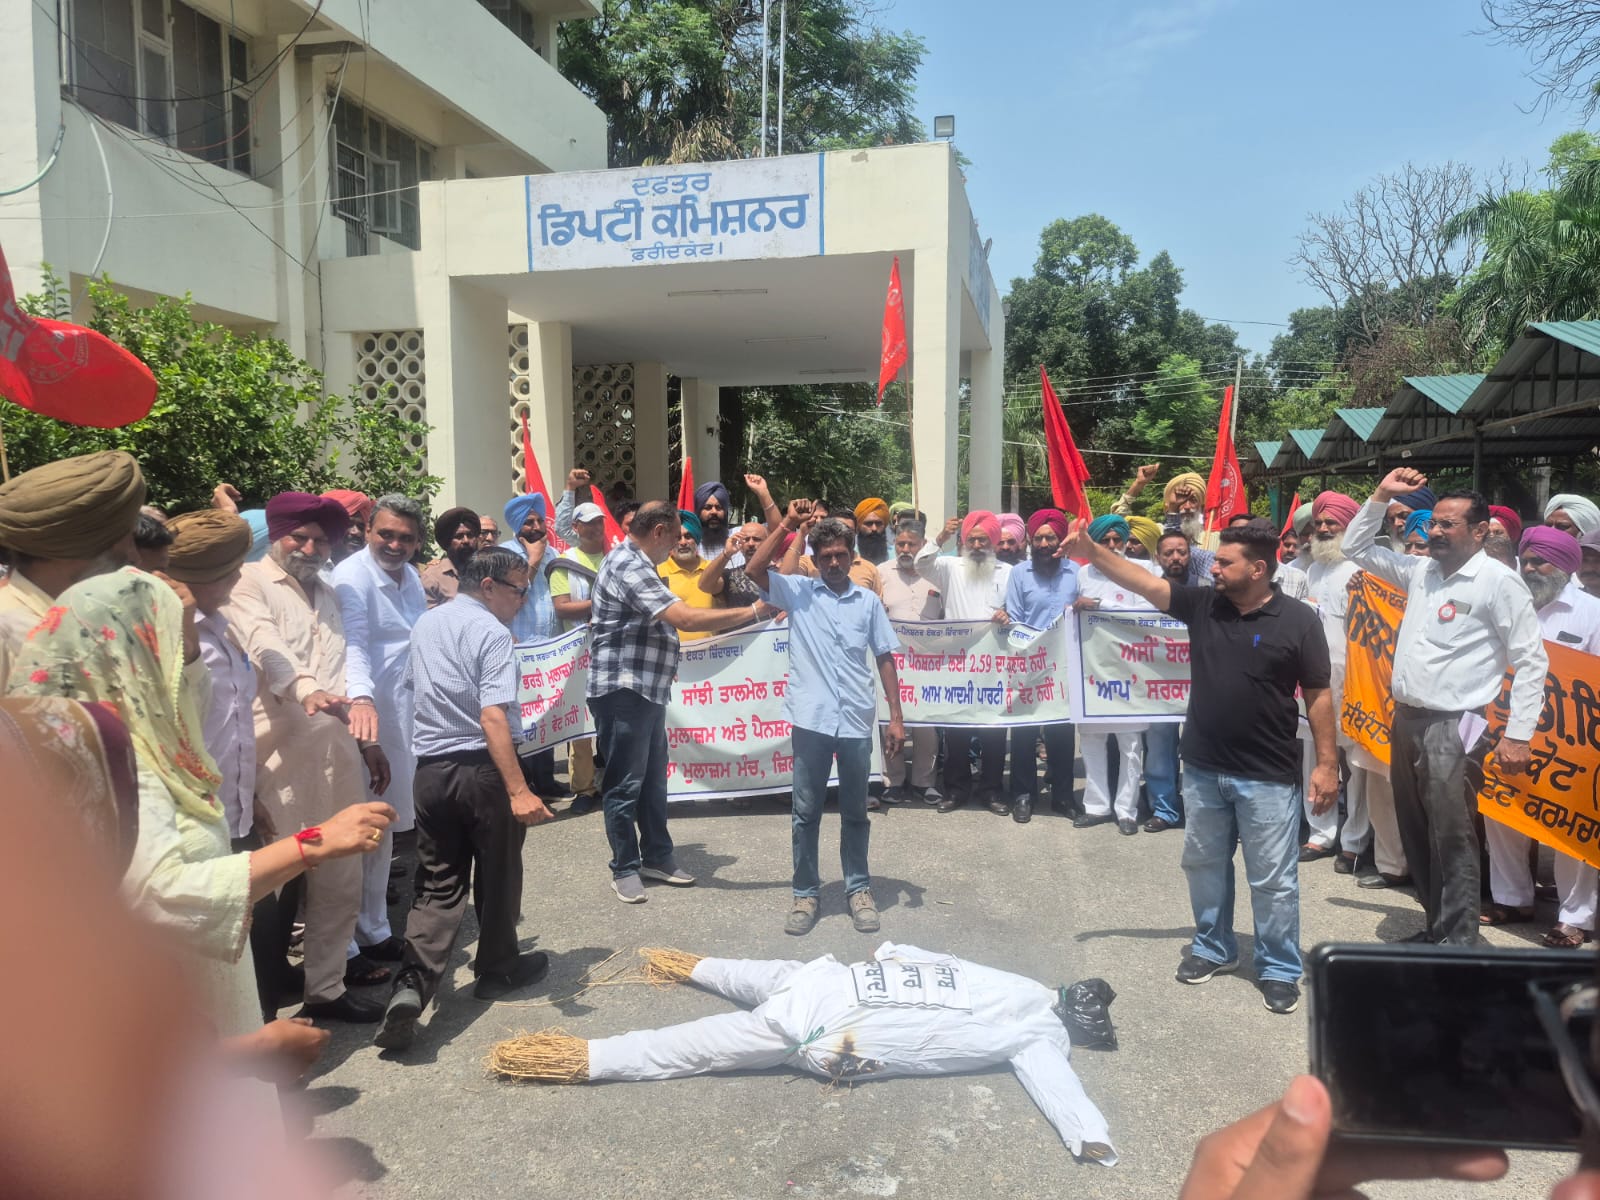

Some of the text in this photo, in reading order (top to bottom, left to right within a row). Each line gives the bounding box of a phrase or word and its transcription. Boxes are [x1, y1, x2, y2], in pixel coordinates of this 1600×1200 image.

[538, 193, 810, 246] ਡਿਪਟੀ ਕਮਿਸ਼ਨਰ
[969, 654, 992, 673] 2.59
[945, 680, 974, 705] ਆਦਮੀ
[977, 680, 1003, 705] ਪਾਰਟੀ
[1145, 679, 1191, 701] ਸਰਕਾ
[721, 717, 748, 743] ਅਤੇ
[751, 714, 794, 740] ਪੈਨਸ਼ਨ
[1523, 793, 1600, 845] ਕਰਮਚਾ
